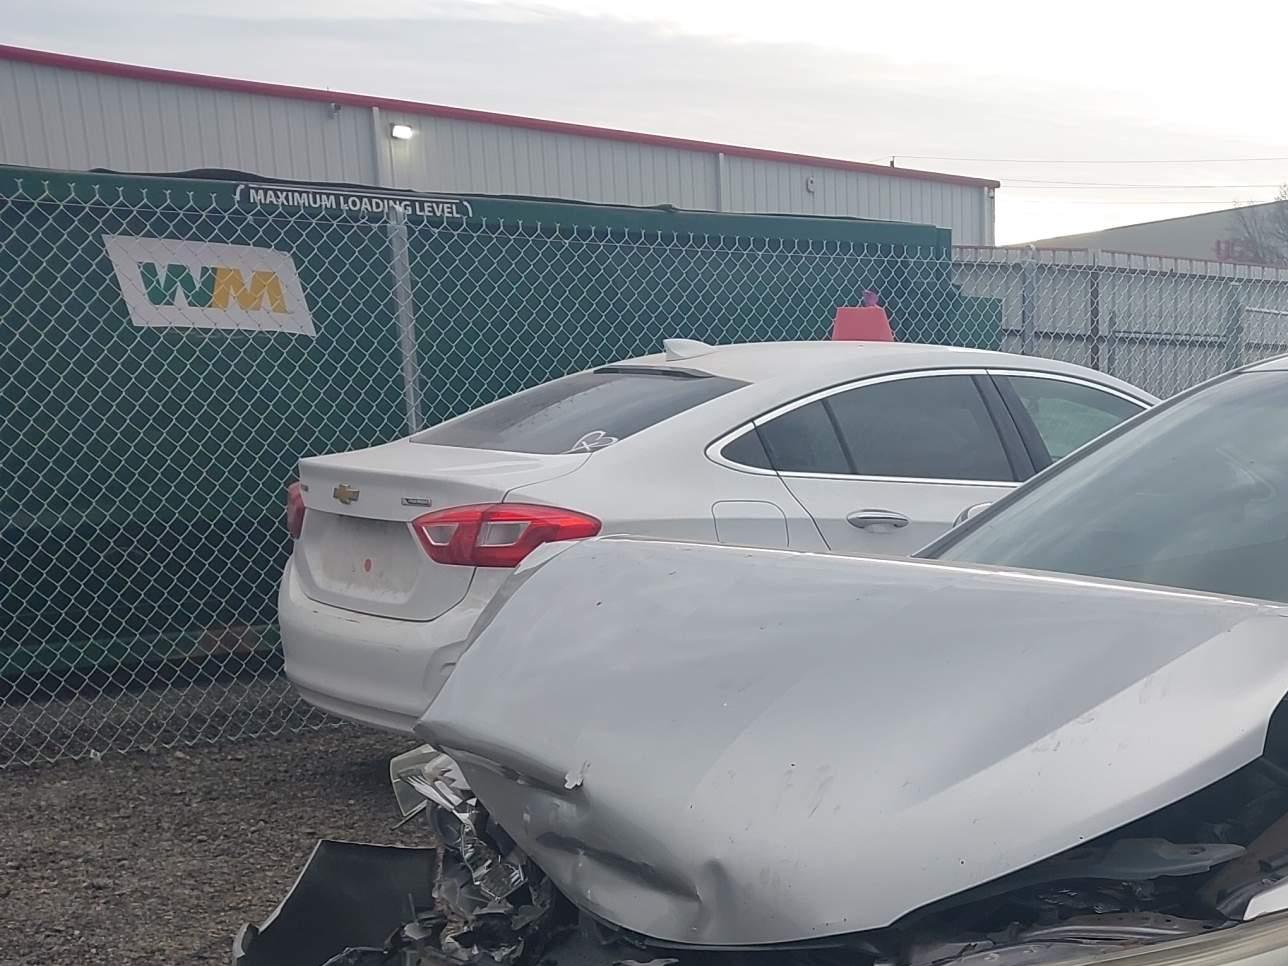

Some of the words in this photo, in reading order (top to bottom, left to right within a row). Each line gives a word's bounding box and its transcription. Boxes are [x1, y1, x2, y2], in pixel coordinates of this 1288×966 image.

[250, 188, 337, 209] MAXIMUM
[340, 196, 412, 215] LOADING
[416, 201, 462, 218] LEVEL
[137, 261, 291, 315] WM
